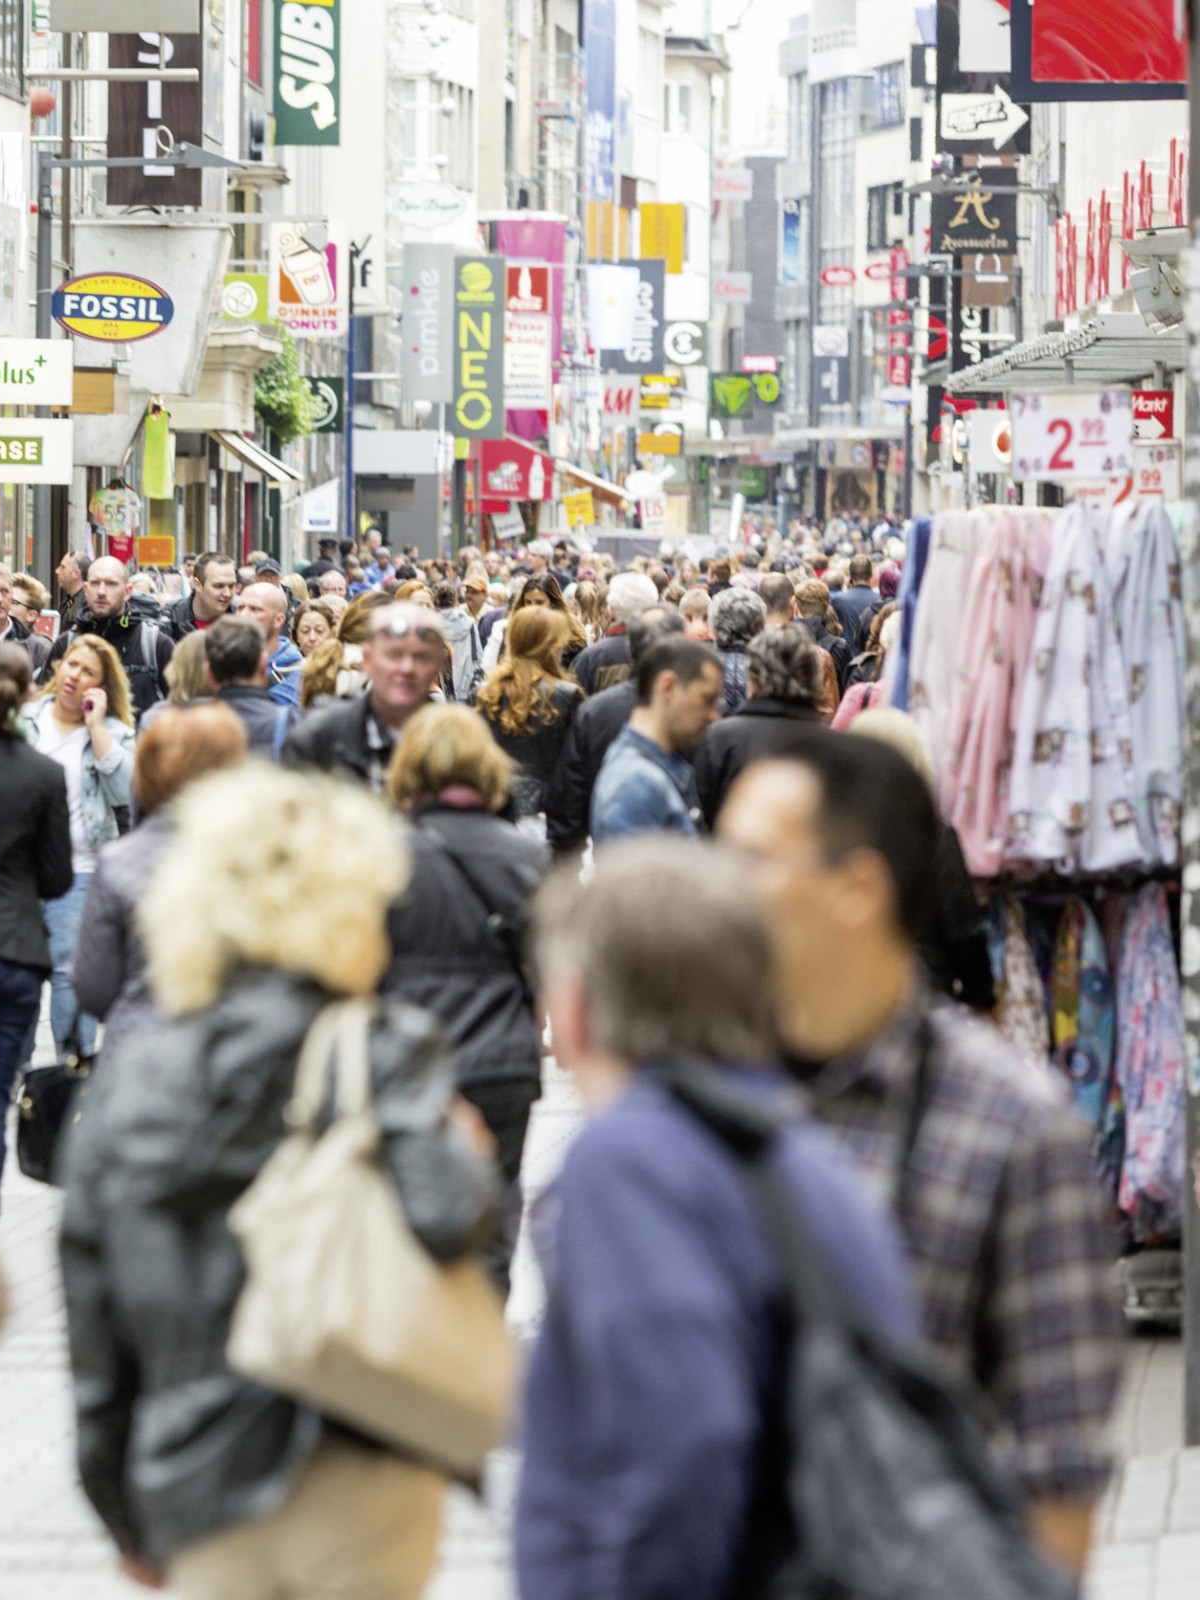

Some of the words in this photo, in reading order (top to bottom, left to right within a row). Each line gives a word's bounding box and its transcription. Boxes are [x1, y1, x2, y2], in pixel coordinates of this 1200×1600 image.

[279, 0, 338, 130] SUB
[64, 295, 163, 321] FOSSIL
[284, 320, 337, 330] ONUTS
[409, 267, 441, 378] pimkie
[456, 311, 493, 431] NEO
[1080, 418, 1106, 437] 99
